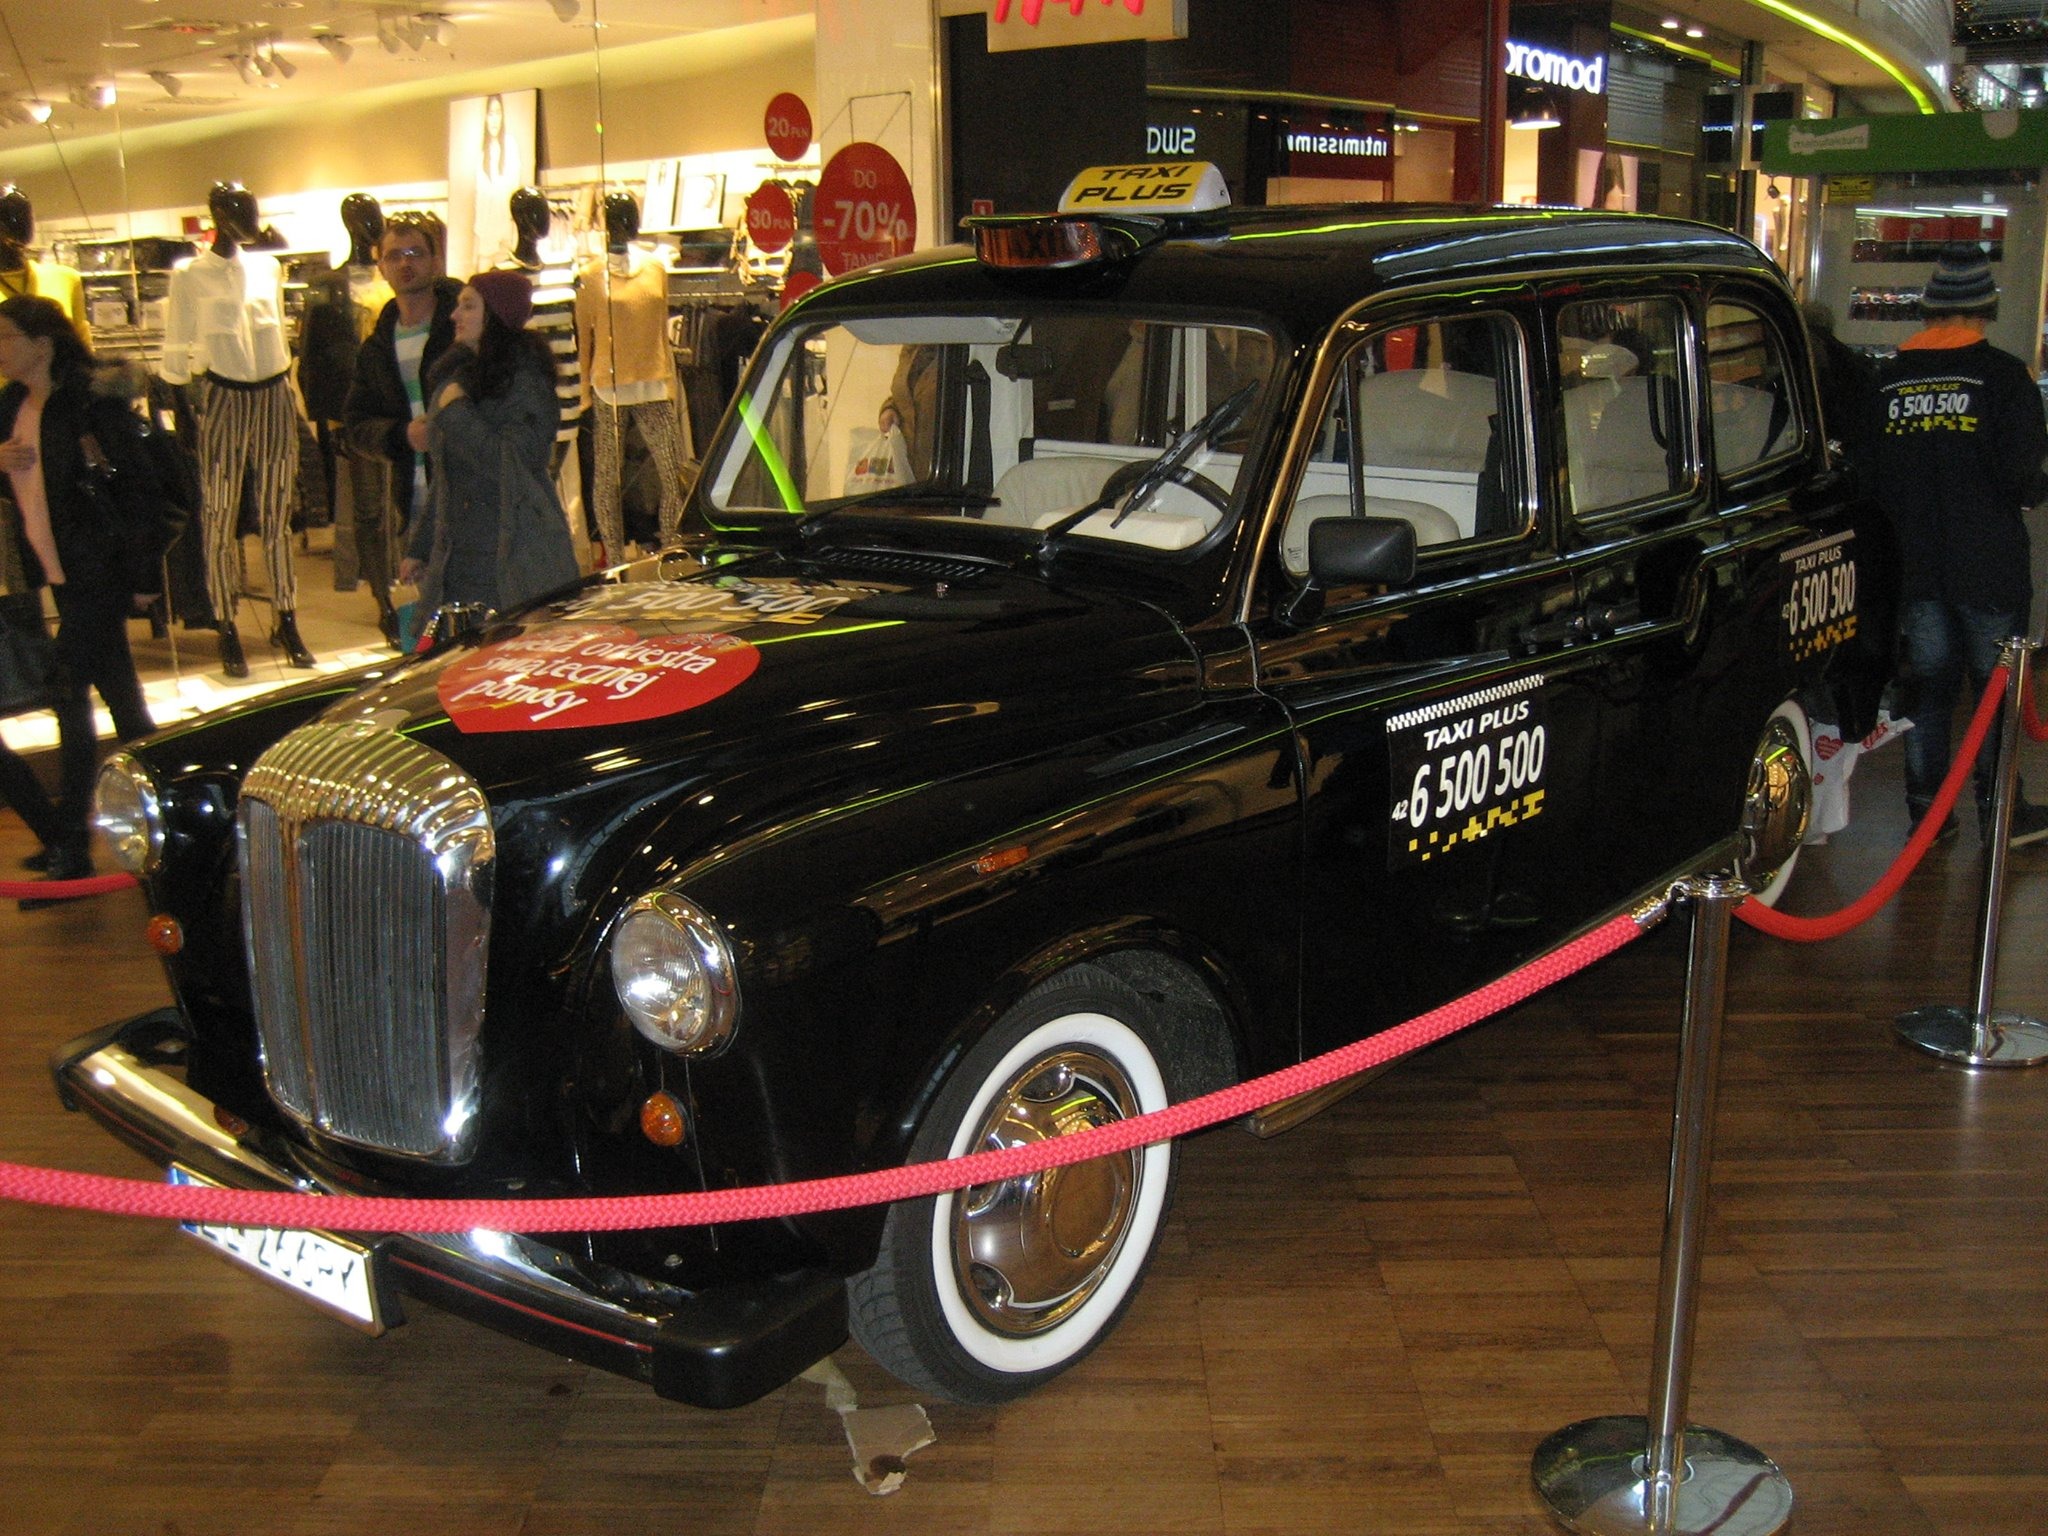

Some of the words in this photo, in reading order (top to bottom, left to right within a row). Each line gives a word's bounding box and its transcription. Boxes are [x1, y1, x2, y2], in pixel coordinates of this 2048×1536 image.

[768, 117, 790, 137] 20
[853, 169, 877, 189] DO
[1100, 165, 1192, 181] TAXI
[1073, 183, 1193, 203] PLUS
[750, 208, 772, 229] 30
[822, 200, 909, 241] -70%
[1898, 385, 1928, 395] TAXI
[1929, 383, 1960, 391] PLUS
[1888, 398, 1900, 420] 6
[1902, 394, 1934, 417] 500
[1934, 393, 1970, 414] 500
[1795, 554, 1818, 574] TAXI
[1818, 545, 1842, 566] PLUS
[1789, 580, 1799, 635] 6
[1801, 570, 1829, 631] 500
[1830, 560, 1856, 619] 500
[449, 678, 589, 722] pomocy
[1423, 717, 1475, 751] TAXI
[1478, 700, 1530, 734] PLUS
[1391, 799, 1409, 821] 42
[1408, 763, 1431, 828] 6
[1434, 743, 1491, 819] 500
[1494, 724, 1546, 796] 500
